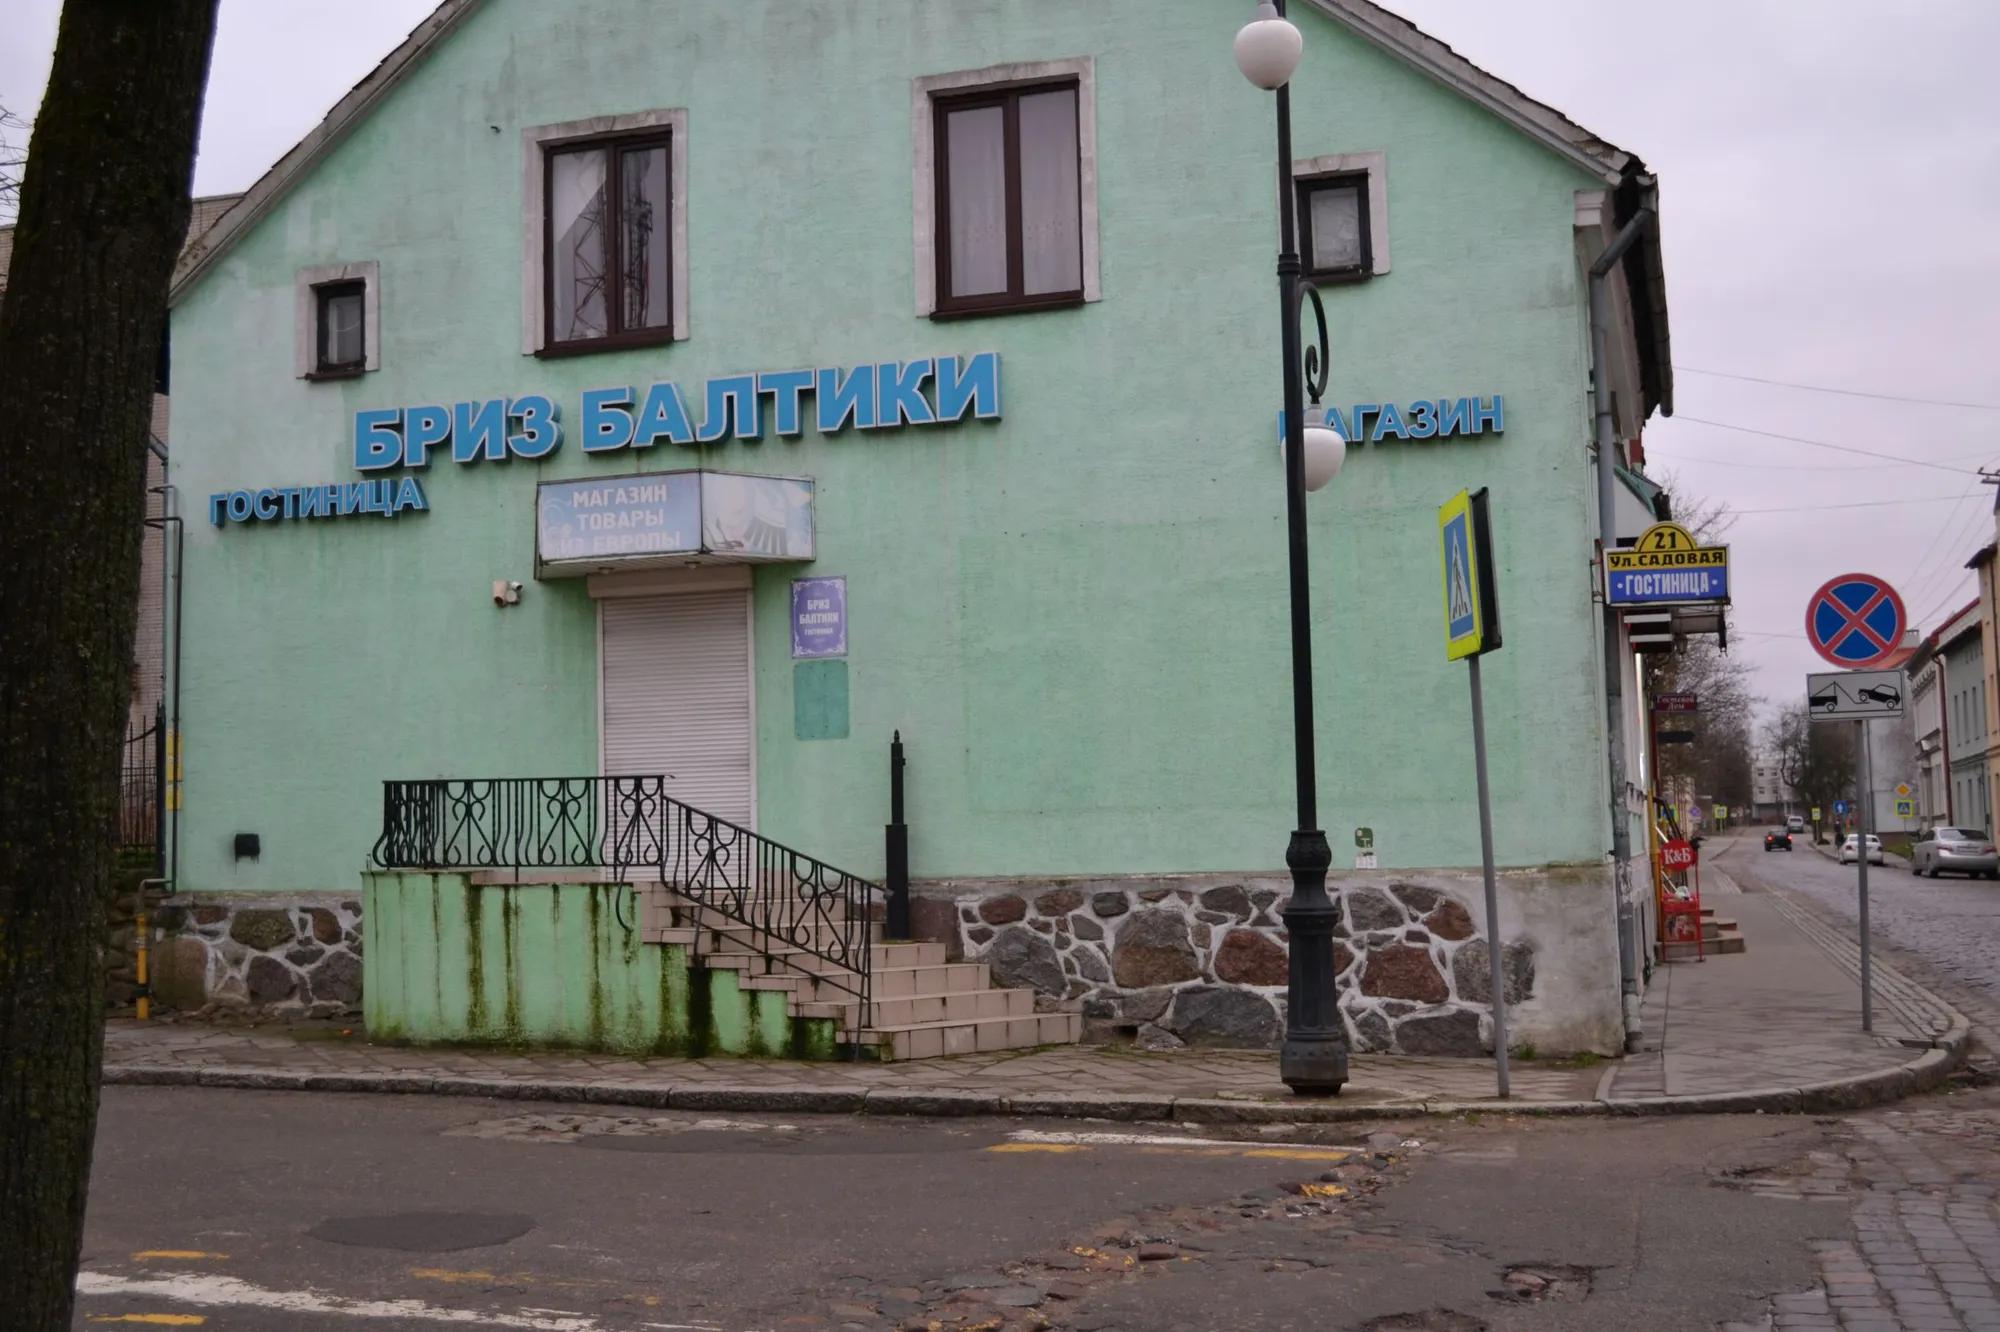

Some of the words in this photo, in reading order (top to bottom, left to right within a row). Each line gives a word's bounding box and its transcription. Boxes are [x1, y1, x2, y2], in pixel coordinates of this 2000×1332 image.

[354, 394, 563, 471] БРИЗ
[581, 352, 1001, 452] БАЛТИКИ
[1277, 394, 1504, 446] АГАЗИН
[208, 476, 428, 528] ГОСТИНИЦА
[572, 484, 667, 508] МАГАЗИН
[576, 508, 664, 532] ТОВАРЫ
[592, 531, 681, 553] ЕВРОПЫ
[1654, 531, 1677, 549] 21
[1625, 572, 1709, 595] ГОСТИНИЦА
[807, 599, 830, 610] БРИЗ
[799, 612, 840, 624] БАЛТИКИ
